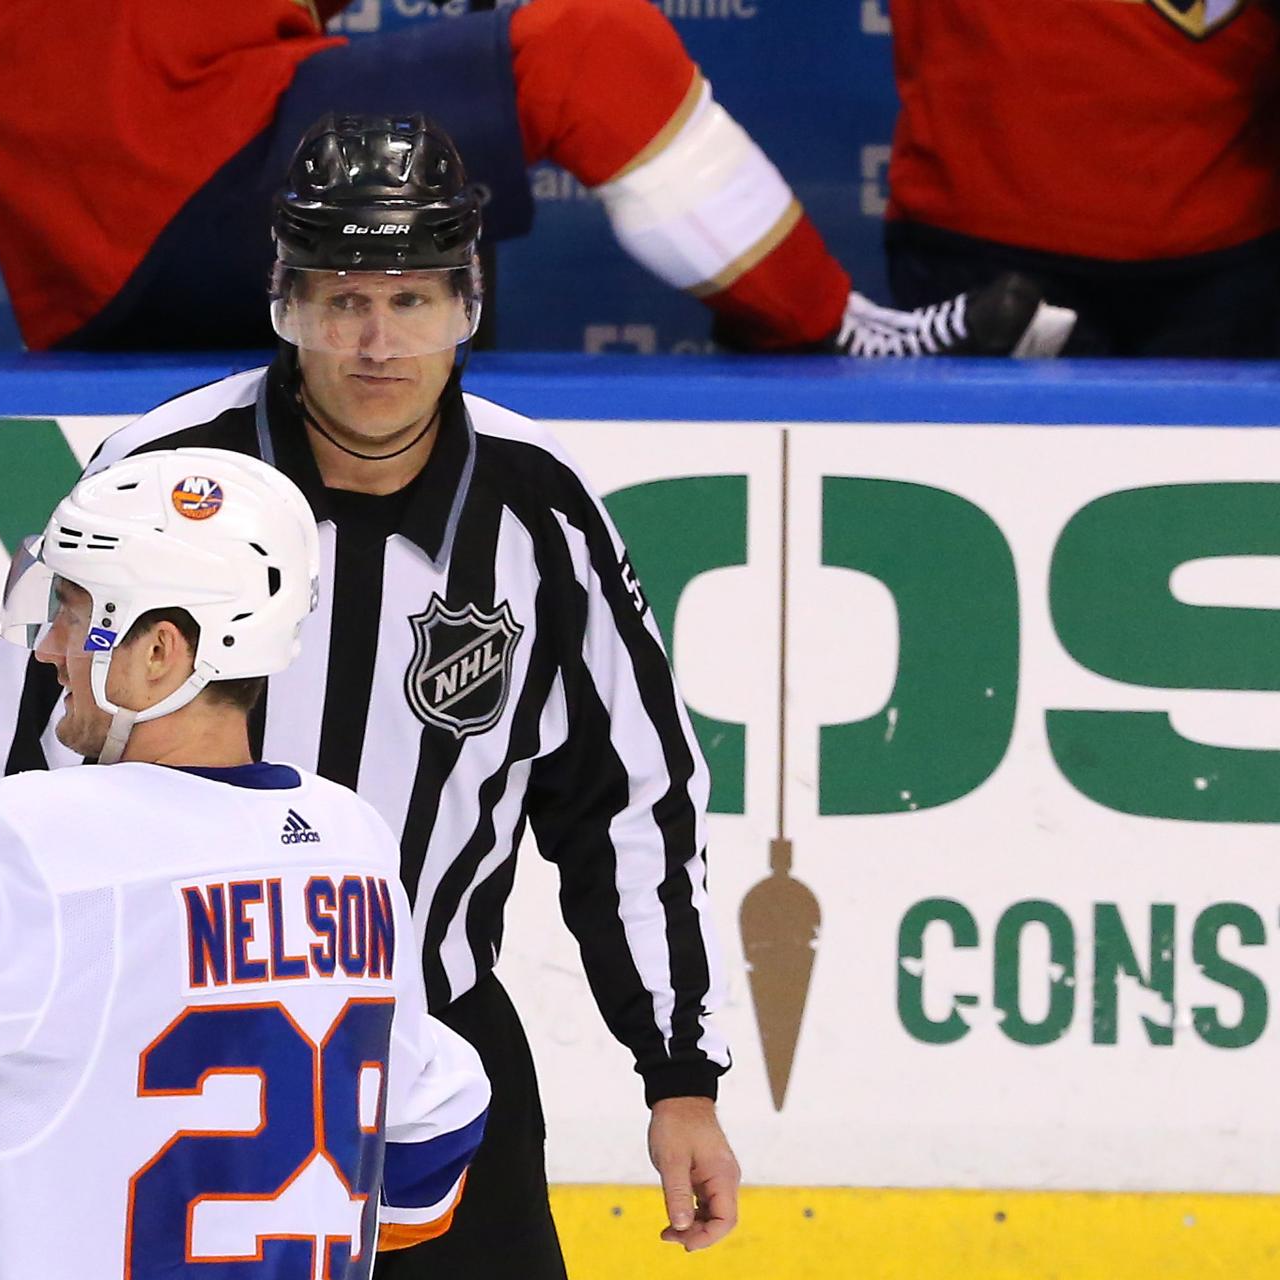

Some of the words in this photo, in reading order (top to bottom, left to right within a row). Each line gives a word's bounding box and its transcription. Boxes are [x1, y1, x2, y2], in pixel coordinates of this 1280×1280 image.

[434, 641, 501, 704] NHL
[280, 829, 321, 845] adidas
[181, 875, 395, 988] NELSON
[897, 896, 1280, 1049] CONS
